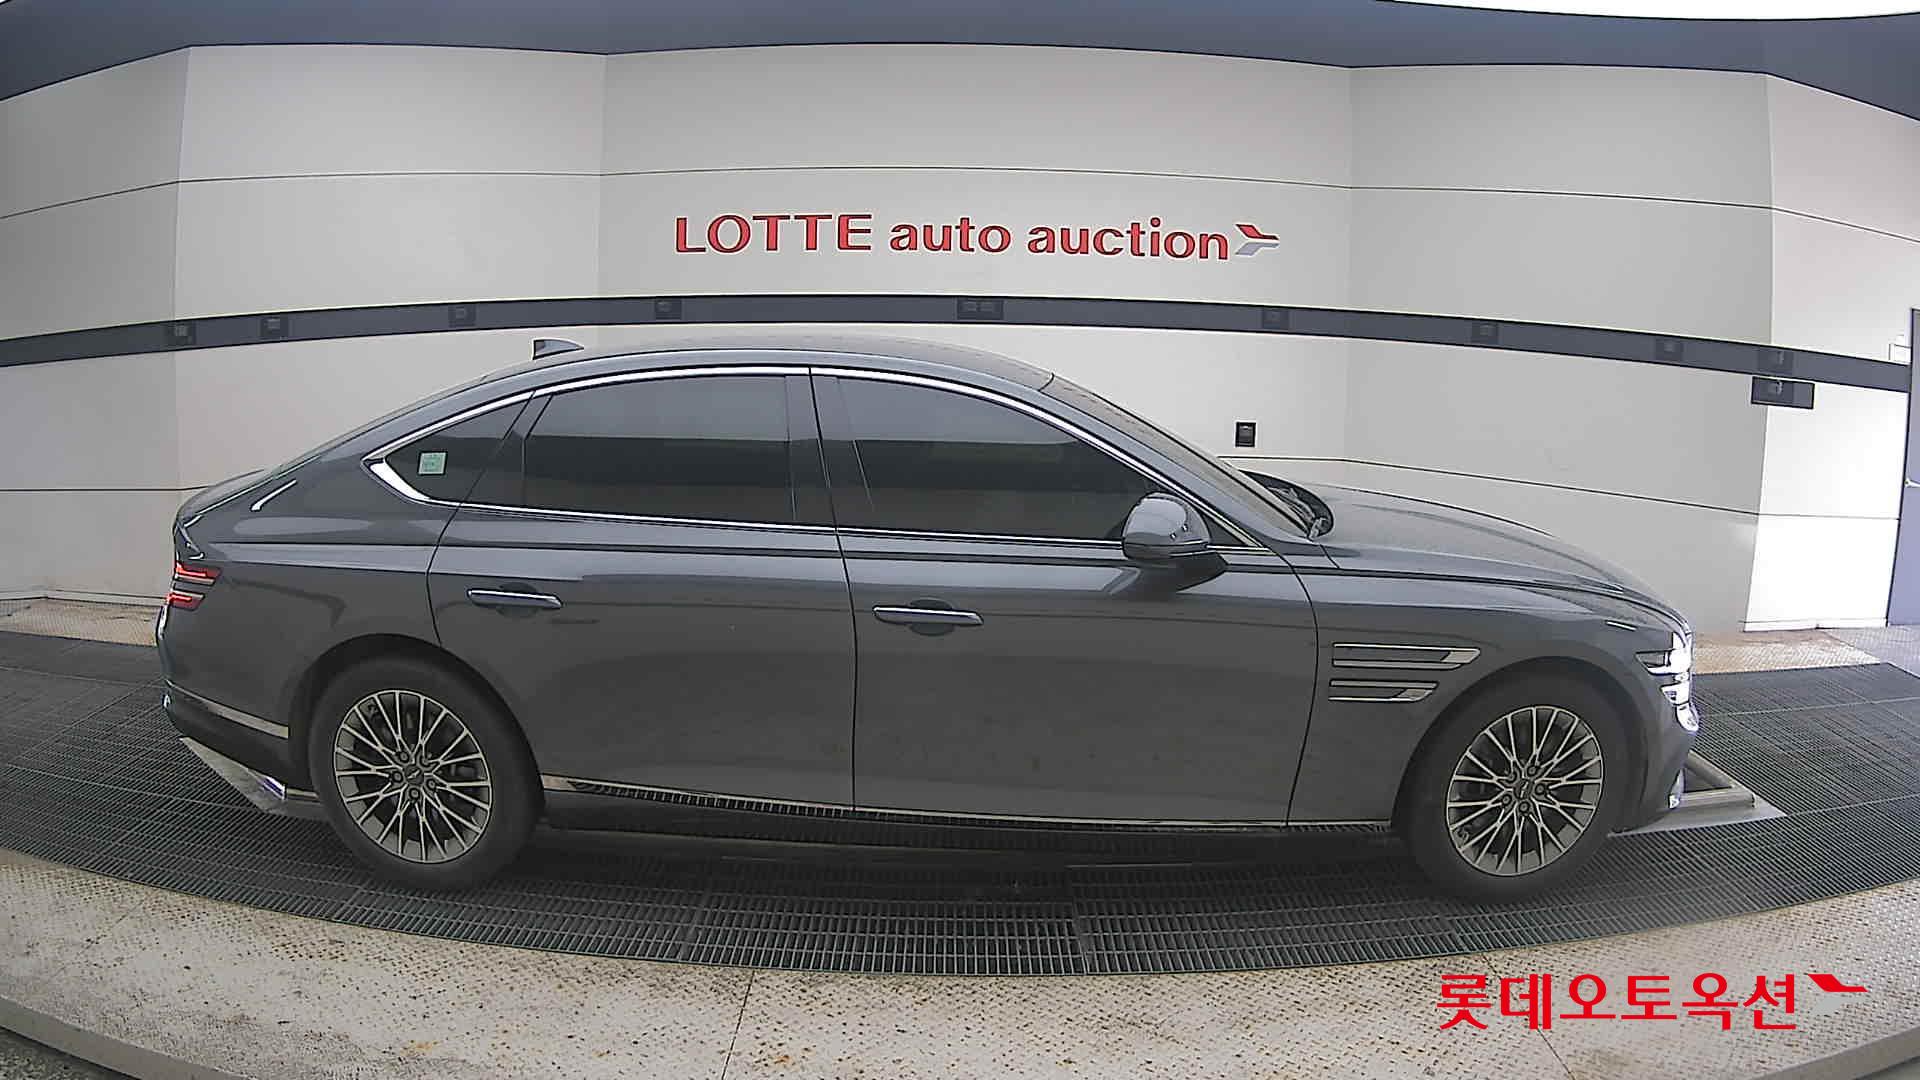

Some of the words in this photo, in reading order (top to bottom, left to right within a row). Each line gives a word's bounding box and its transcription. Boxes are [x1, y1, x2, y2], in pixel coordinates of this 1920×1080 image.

[675, 214, 872, 254] LOTTE
[889, 217, 1012, 253] auto
[1027, 216, 1229, 260] auction
